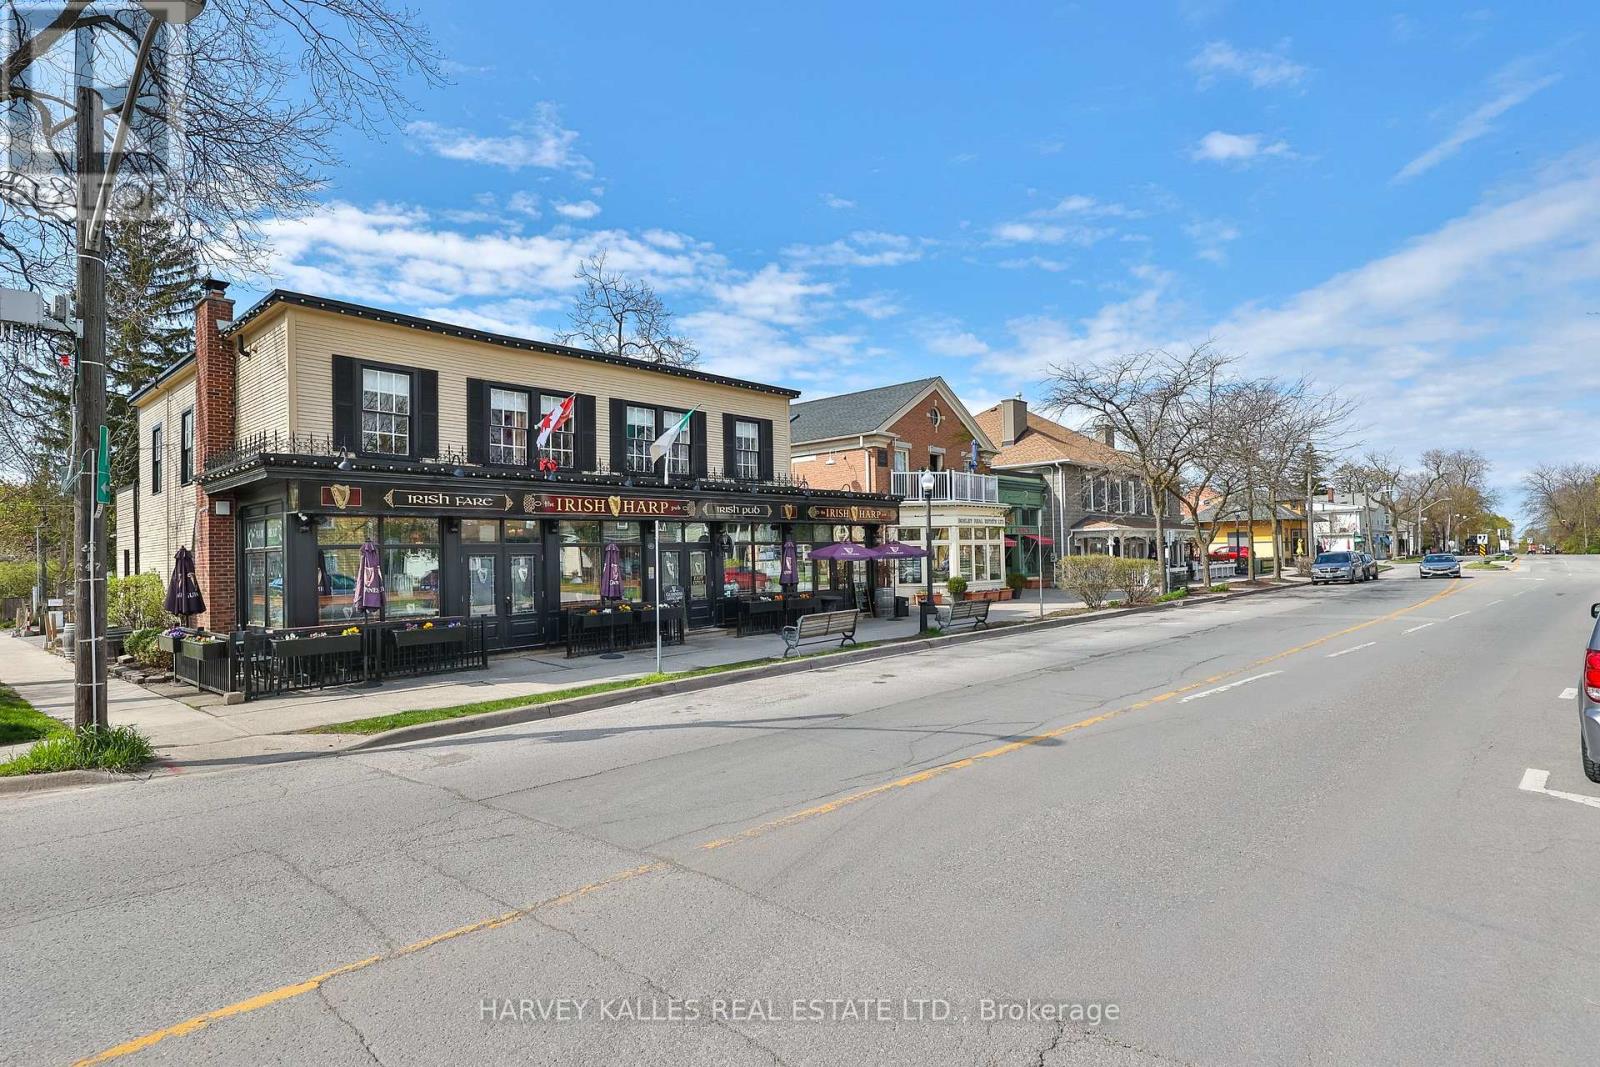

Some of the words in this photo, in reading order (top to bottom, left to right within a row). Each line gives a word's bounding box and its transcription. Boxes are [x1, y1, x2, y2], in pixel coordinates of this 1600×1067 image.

[455, 496, 494, 506] FARE
[556, 498, 606, 513] IRISH
[623, 500, 669, 514] HARP
[826, 508, 849, 518] IRISH
[859, 509, 882, 519] HARP
